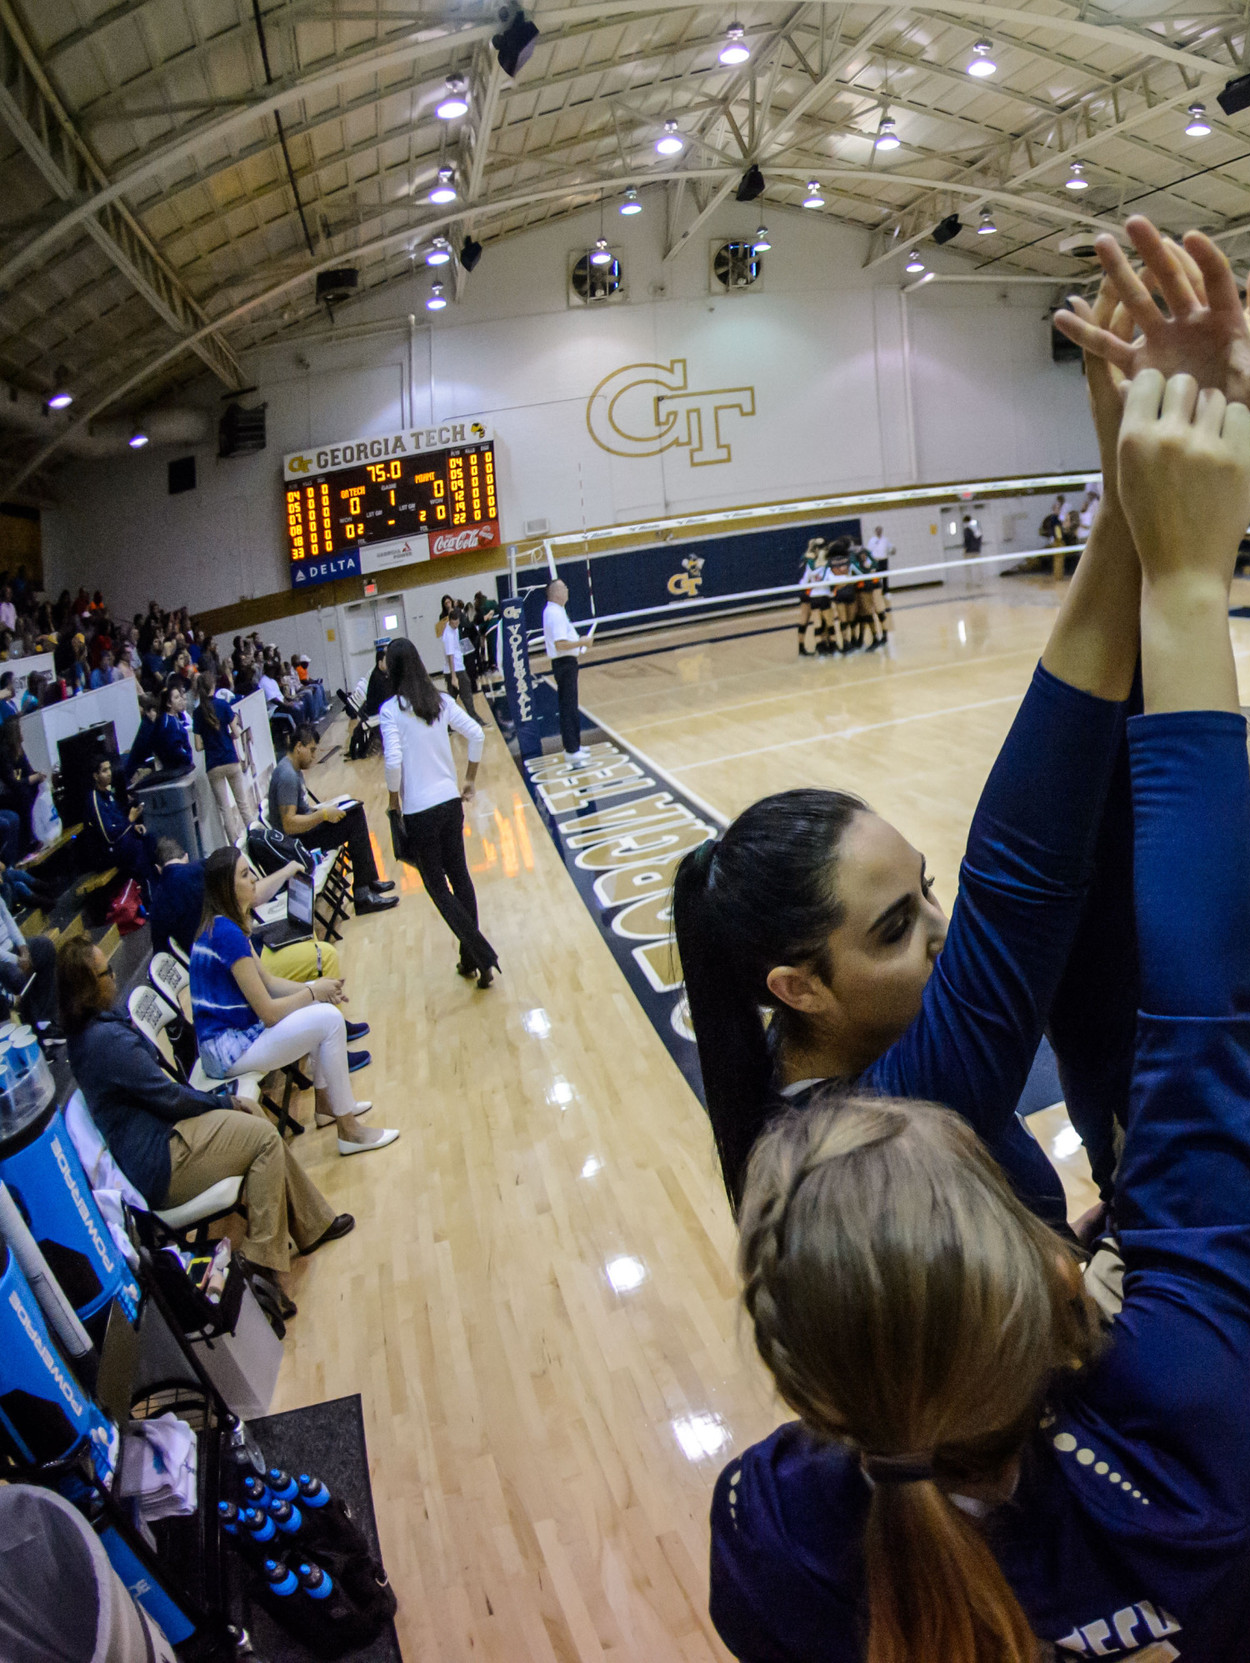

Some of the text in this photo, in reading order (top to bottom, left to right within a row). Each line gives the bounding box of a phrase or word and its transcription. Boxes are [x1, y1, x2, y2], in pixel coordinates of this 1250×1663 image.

[316, 424, 466, 469] GEORGIA TECH
[449, 452, 492, 468] 04 0 0
[366, 461, 401, 482] 75.0
[450, 463, 492, 480] 05 0 0
[434, 480, 444, 498] 0
[451, 474, 493, 491] 09 0 0
[287, 484, 328, 502] 04 0 0
[390, 490, 395, 506] 1
[455, 485, 494, 501] 12 0 0
[288, 496, 329, 514] 05 0 0
[350, 497, 360, 515] 0
[456, 496, 495, 512] 19 0 0
[289, 507, 330, 525] 07 0 0
[420, 505, 446, 522] 2 0
[453, 507, 496, 525] 22 0 0
[290, 518, 330, 537] 08 0 0
[345, 523, 364, 539] 0 2
[294, 530, 331, 546] 18 0 0
[292, 541, 332, 560] 33 0 0
[310, 558, 356, 577] DELTA
[51, 1132, 115, 1273] POWERADE
[8, 1290, 82, 1417] POWERADE
